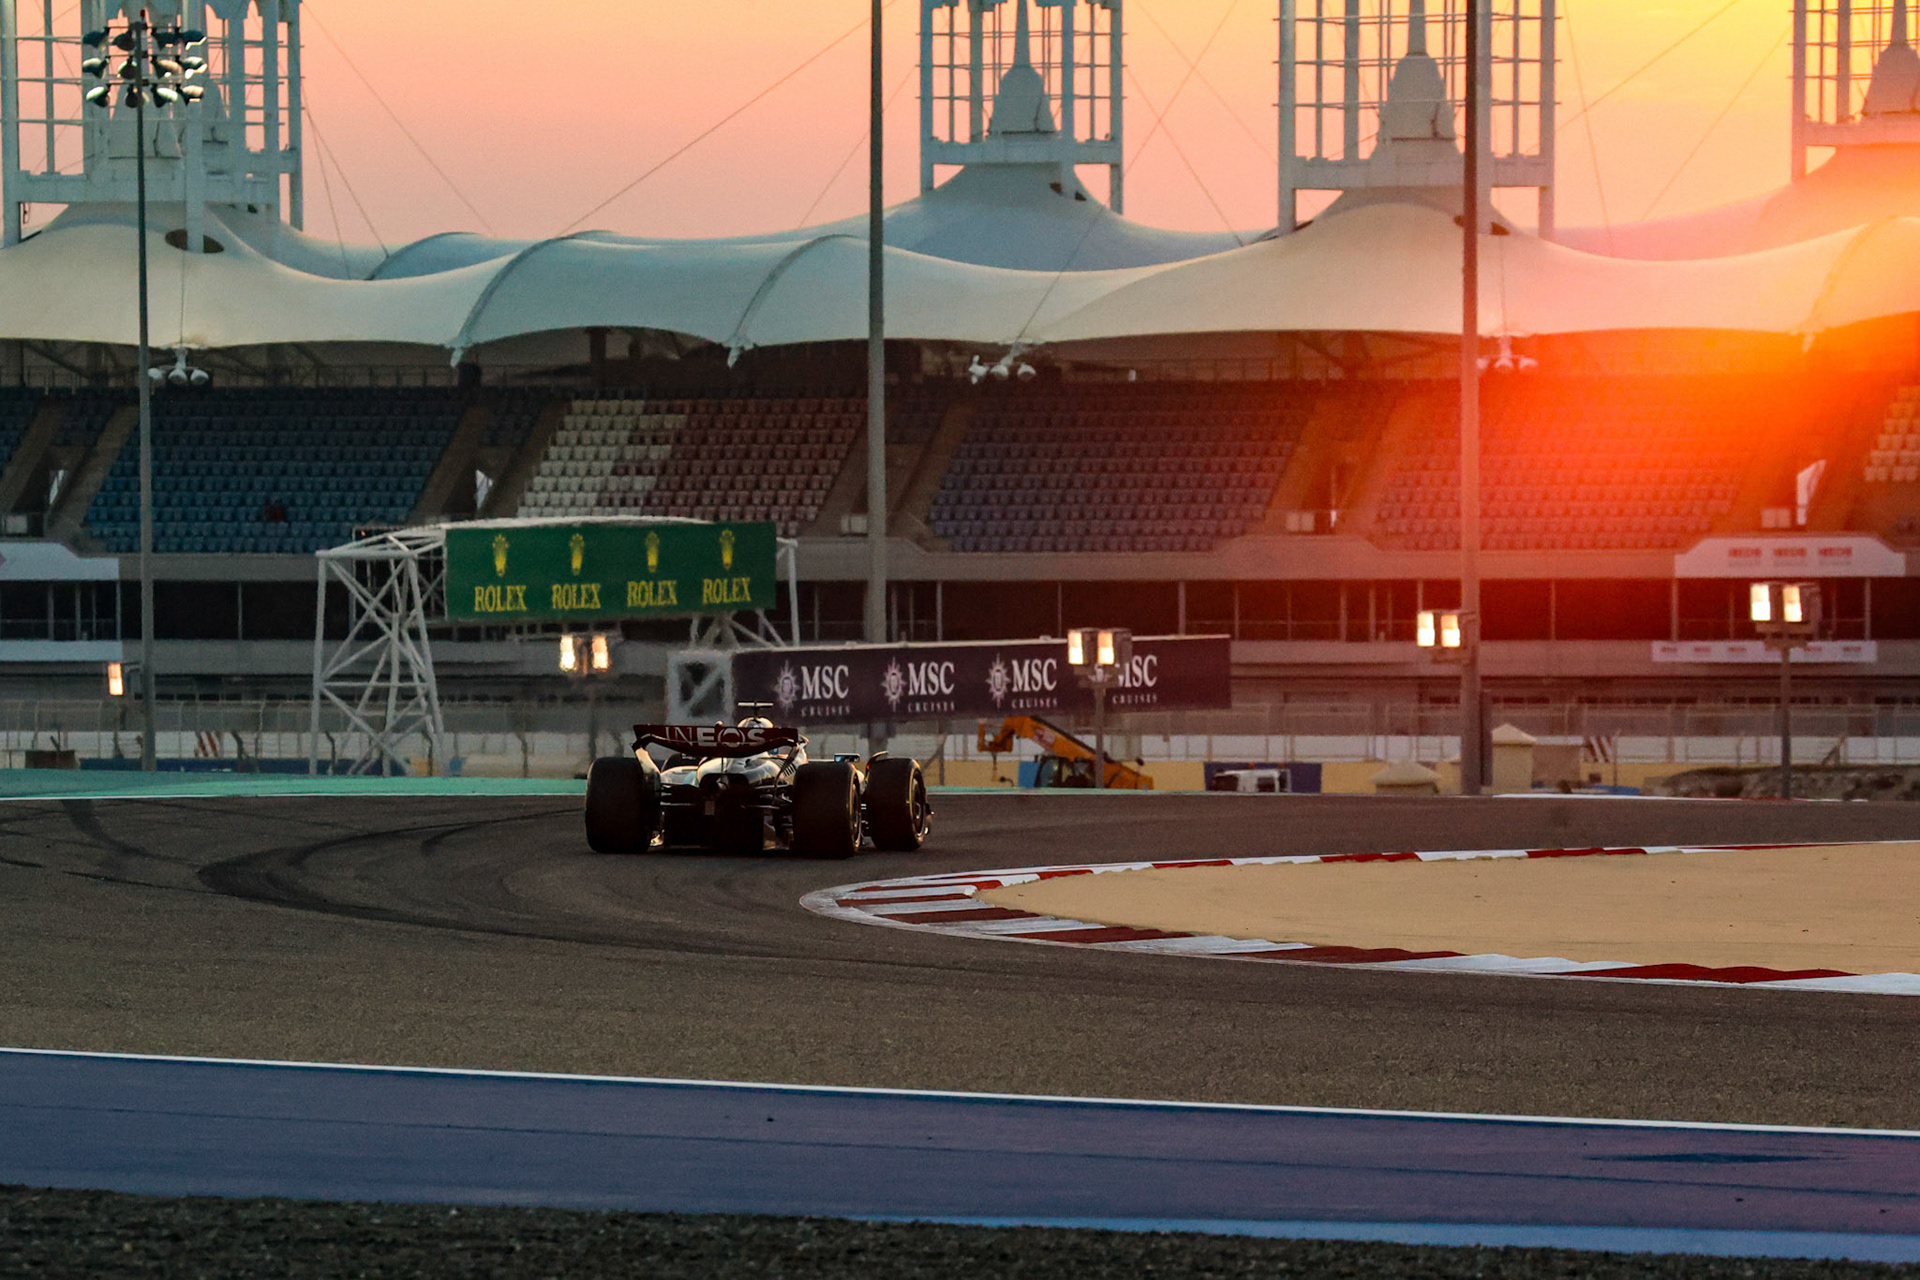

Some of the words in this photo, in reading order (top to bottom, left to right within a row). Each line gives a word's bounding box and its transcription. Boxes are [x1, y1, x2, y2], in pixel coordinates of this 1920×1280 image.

[474, 585, 527, 612] ROLEX
[551, 583, 602, 610] ROLEX
[627, 580, 678, 608] ROLEX
[702, 577, 752, 605] ROLEX
[801, 665, 850, 700] MSC
[908, 662, 955, 696] MSC
[1012, 658, 1058, 693] MSC
[665, 726, 766, 748] INEOS
